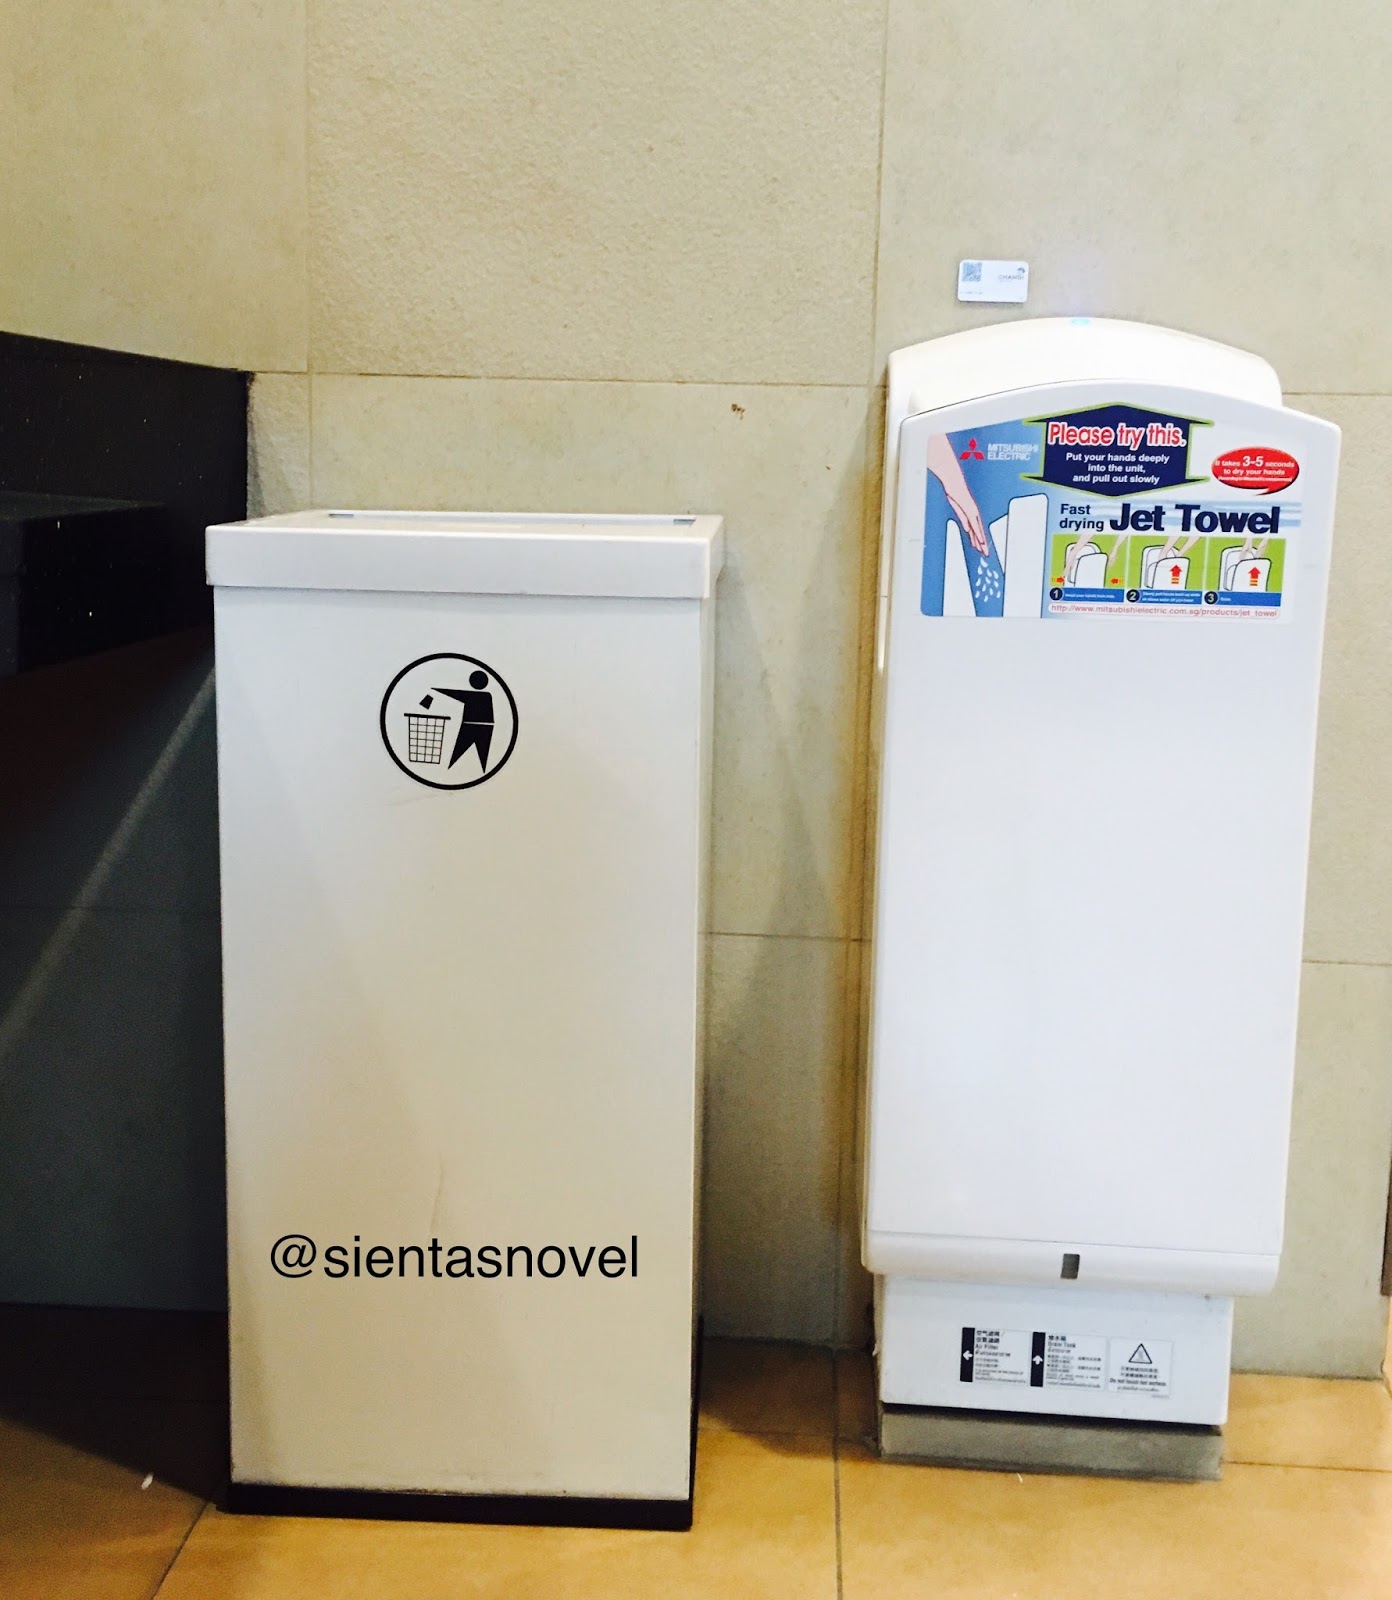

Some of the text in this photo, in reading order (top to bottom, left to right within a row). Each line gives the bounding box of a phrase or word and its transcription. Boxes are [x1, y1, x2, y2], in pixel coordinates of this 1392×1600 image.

[1048, 422, 1187, 450] Please try this.
[987, 443, 1039, 452] MITSUBISHI
[987, 452, 1031, 461] ELECTRIC
[1066, 452, 1170, 464] Put your hands deeply
[1242, 455, 1264, 467] 3-5
[1088, 463, 1146, 473] into the unit,
[1232, 468, 1244, 476] dry
[1072, 474, 1160, 485] and pull out slowly
[1060, 503, 1091, 515] Fast
[1110, 503, 1281, 534] Jet Towel
[1059, 518, 1105, 532] drying
